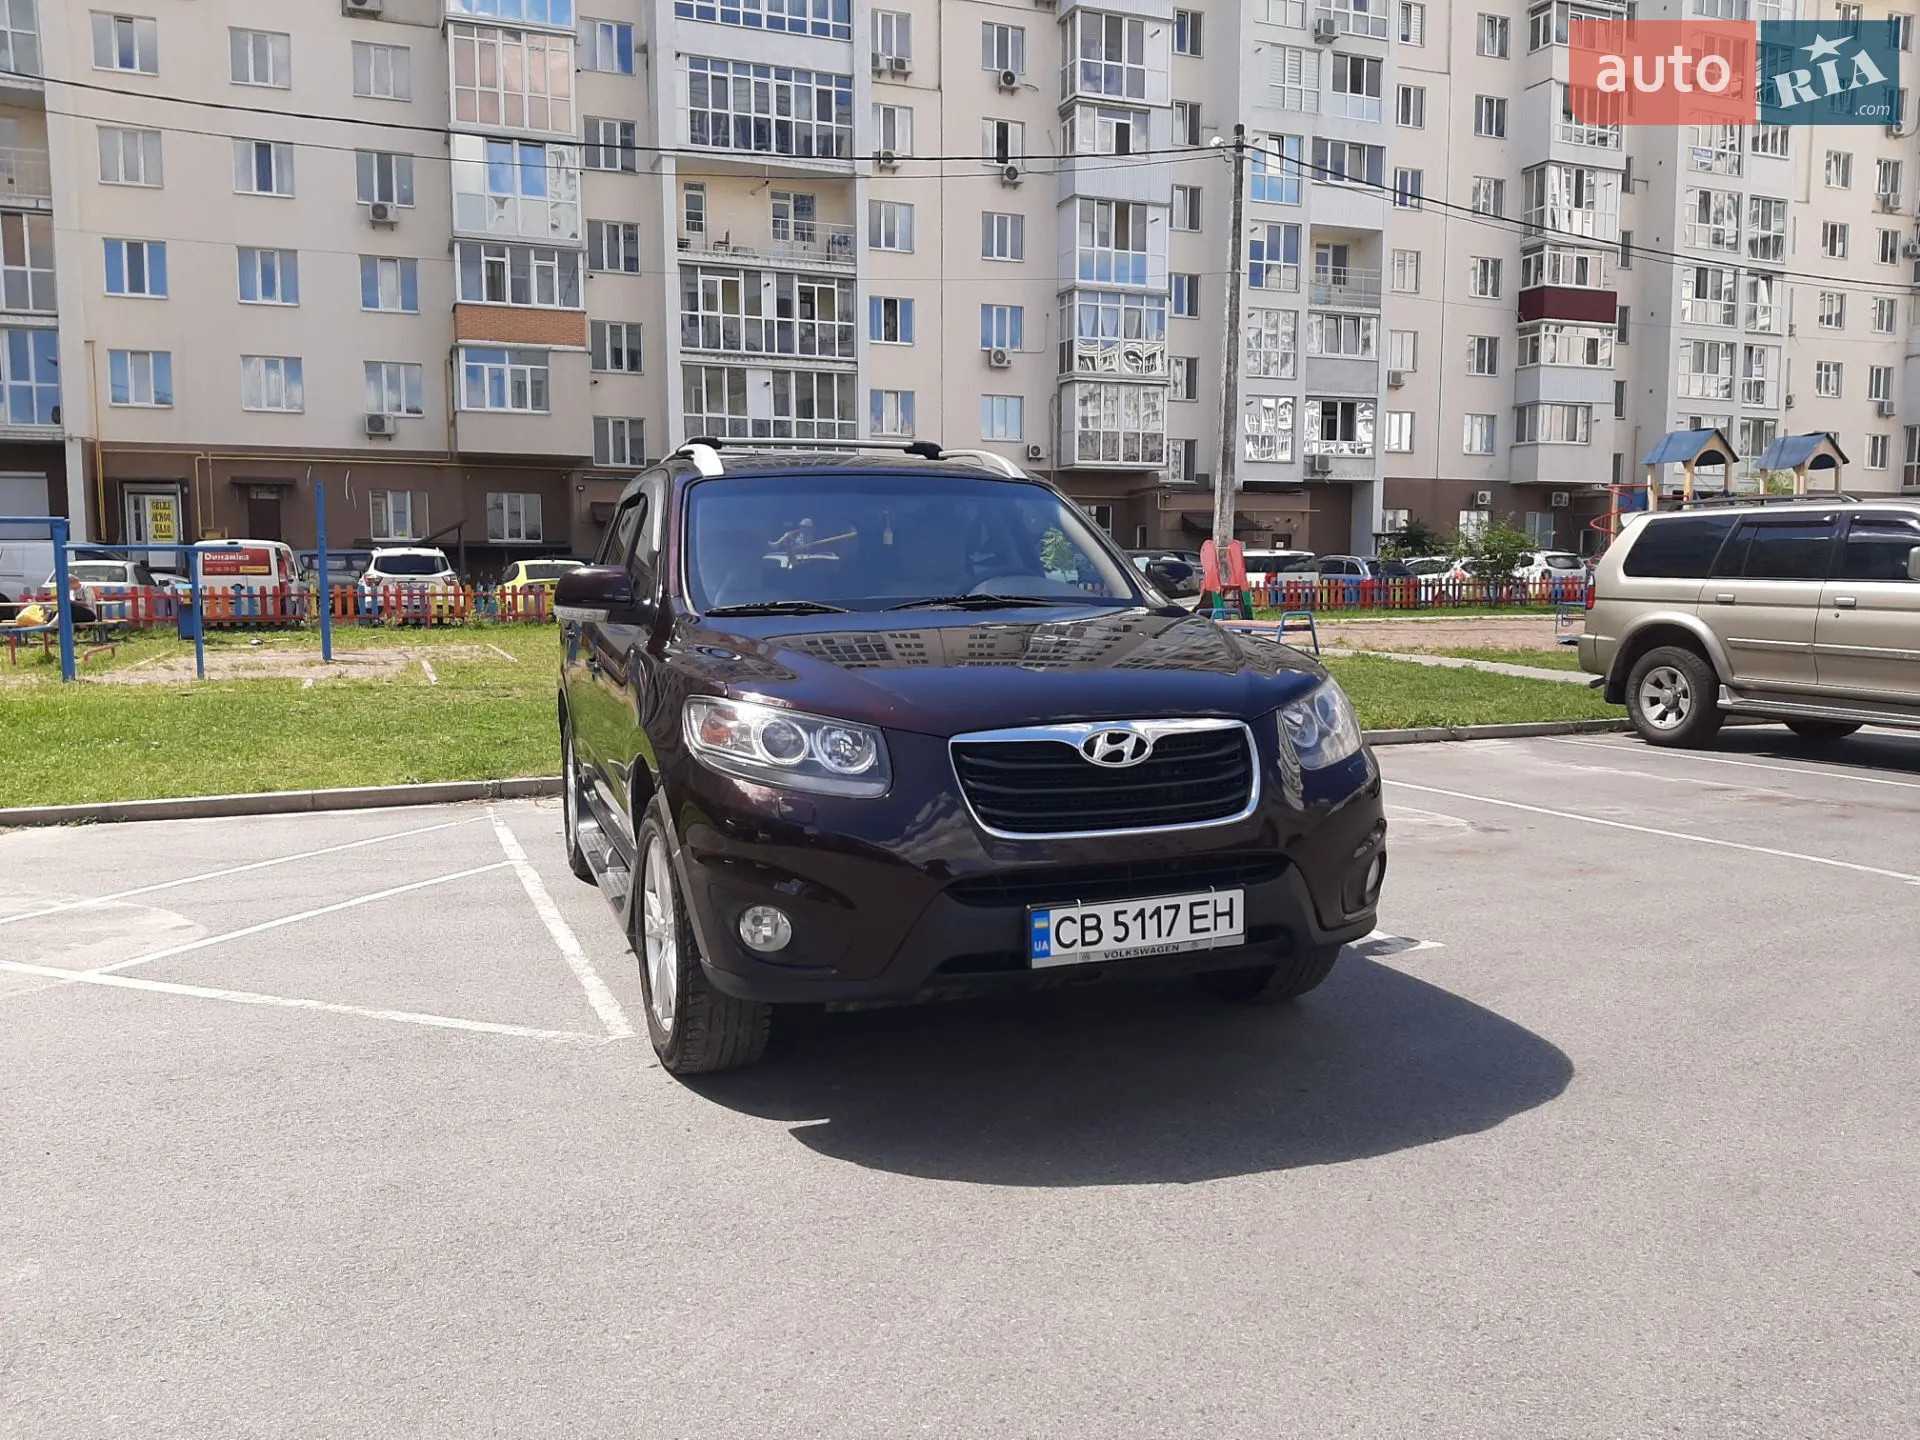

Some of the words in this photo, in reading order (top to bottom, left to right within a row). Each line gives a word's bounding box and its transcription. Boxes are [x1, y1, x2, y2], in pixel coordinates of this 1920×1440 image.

[1054, 912, 1104, 949] CB
[1112, 903, 1181, 943] 5117
[1189, 897, 1234, 935] EH
[1034, 940, 1049, 952] UA
[1103, 944, 1180, 960] VOLKSWAGEN
